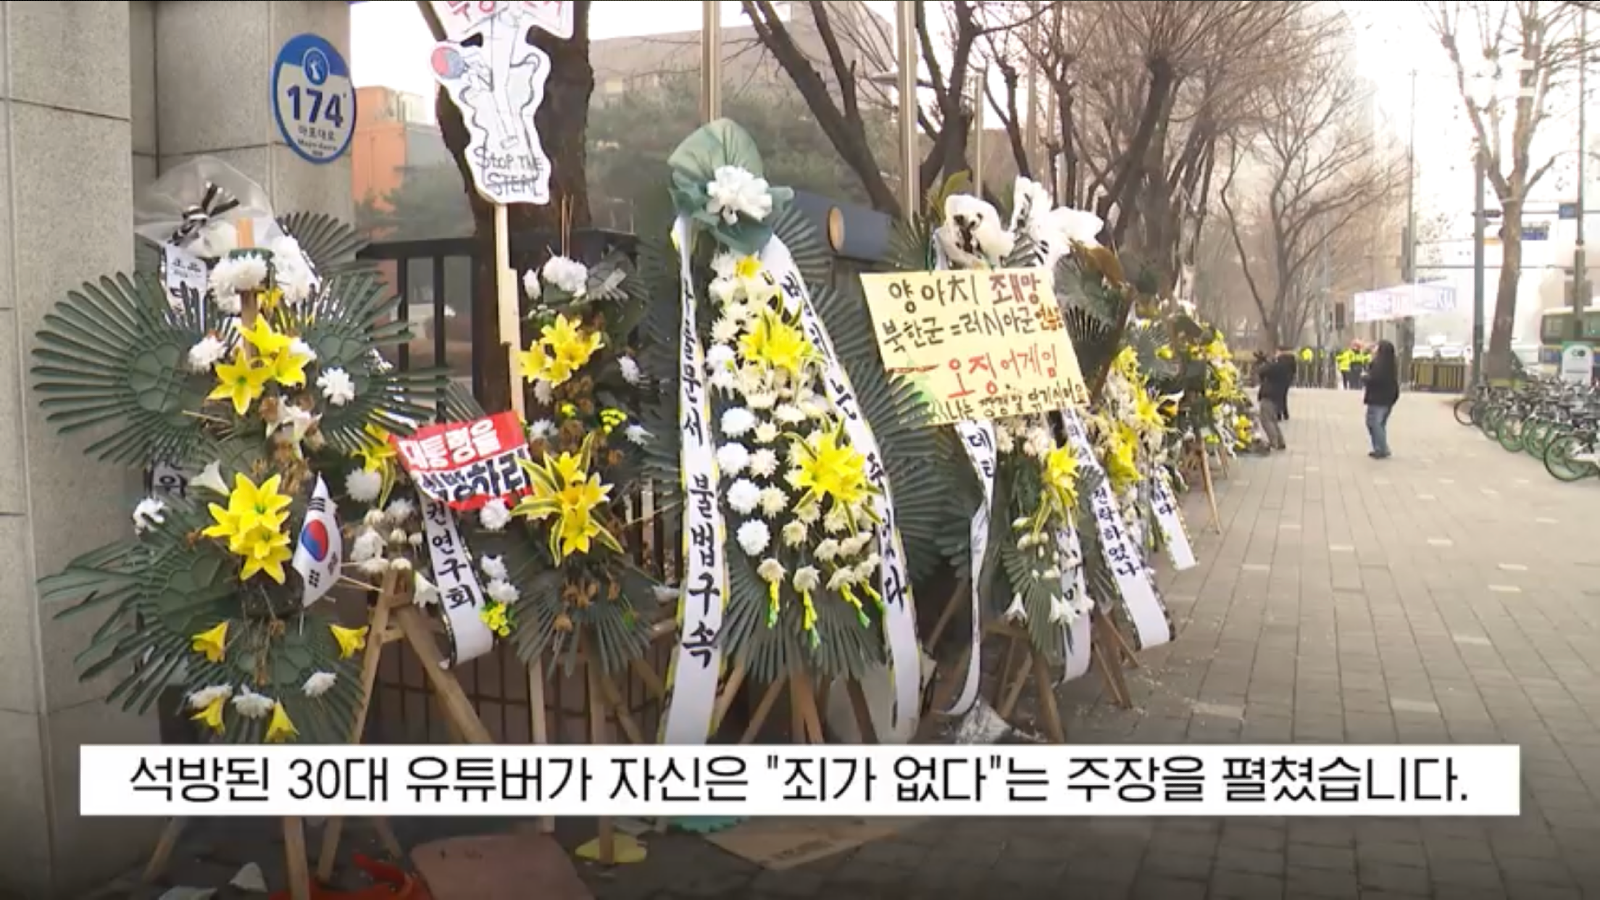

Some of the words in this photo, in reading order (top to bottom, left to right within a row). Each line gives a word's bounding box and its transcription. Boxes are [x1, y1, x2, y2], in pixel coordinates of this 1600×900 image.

[287, 83, 343, 128] 174
[889, 273, 980, 314] 양아치
[947, 343, 1058, 399] 오징어게임
[398, 418, 501, 470] 대통령을
[682, 474, 720, 669] 불법구속
